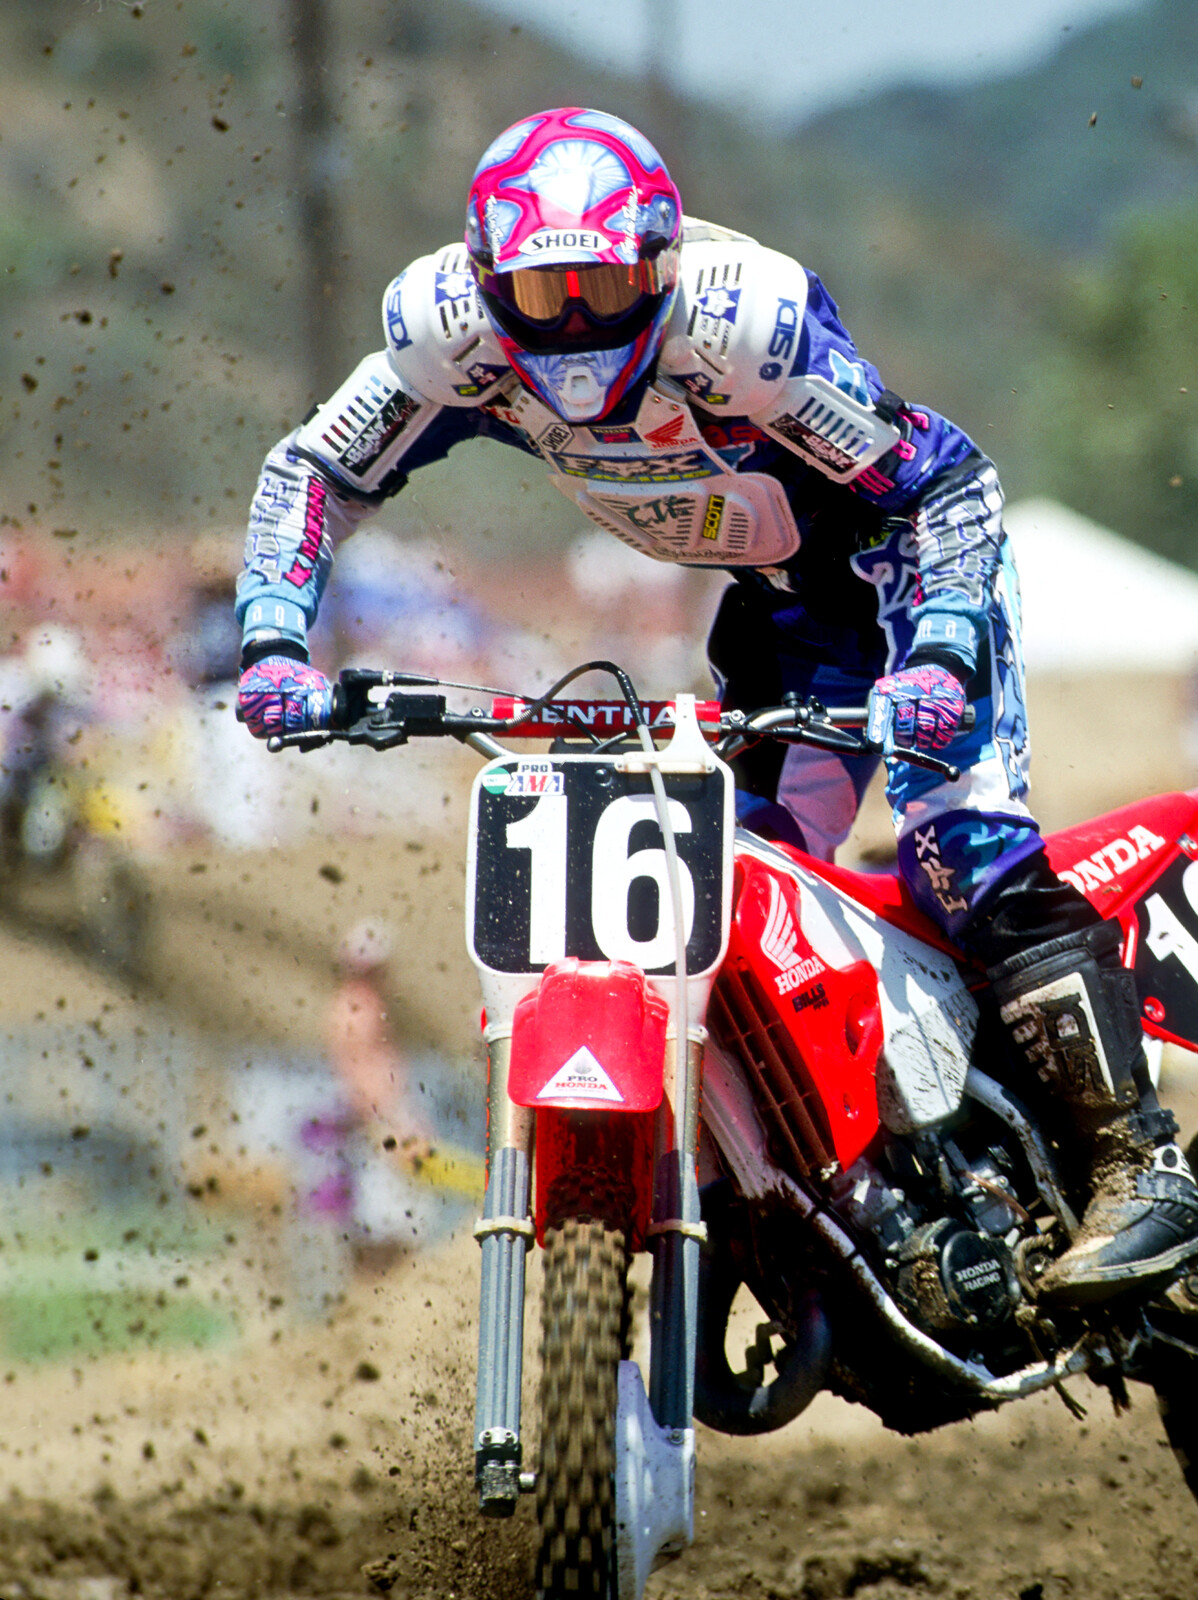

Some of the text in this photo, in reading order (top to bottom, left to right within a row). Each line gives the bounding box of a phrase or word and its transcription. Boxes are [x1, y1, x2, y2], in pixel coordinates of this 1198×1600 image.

[531, 233, 599, 252] SHOEI
[767, 297, 798, 361] SIDI
[542, 425, 570, 451] SHOEI
[651, 436, 698, 449] HONDA
[703, 495, 724, 540] SCOTT
[513, 703, 677, 725] RENTHA
[521, 764, 549, 773] PRO
[508, 775, 561, 793] AMA
[1056, 825, 1166, 896] ONDA
[506, 793, 695, 969] 16
[774, 955, 826, 996] HONDA
[555, 1082, 609, 1091] HONDA
[567, 1075, 598, 1083] PRO
[955, 1259, 1001, 1283] HONDA
[962, 1271, 1001, 1293] RACING
